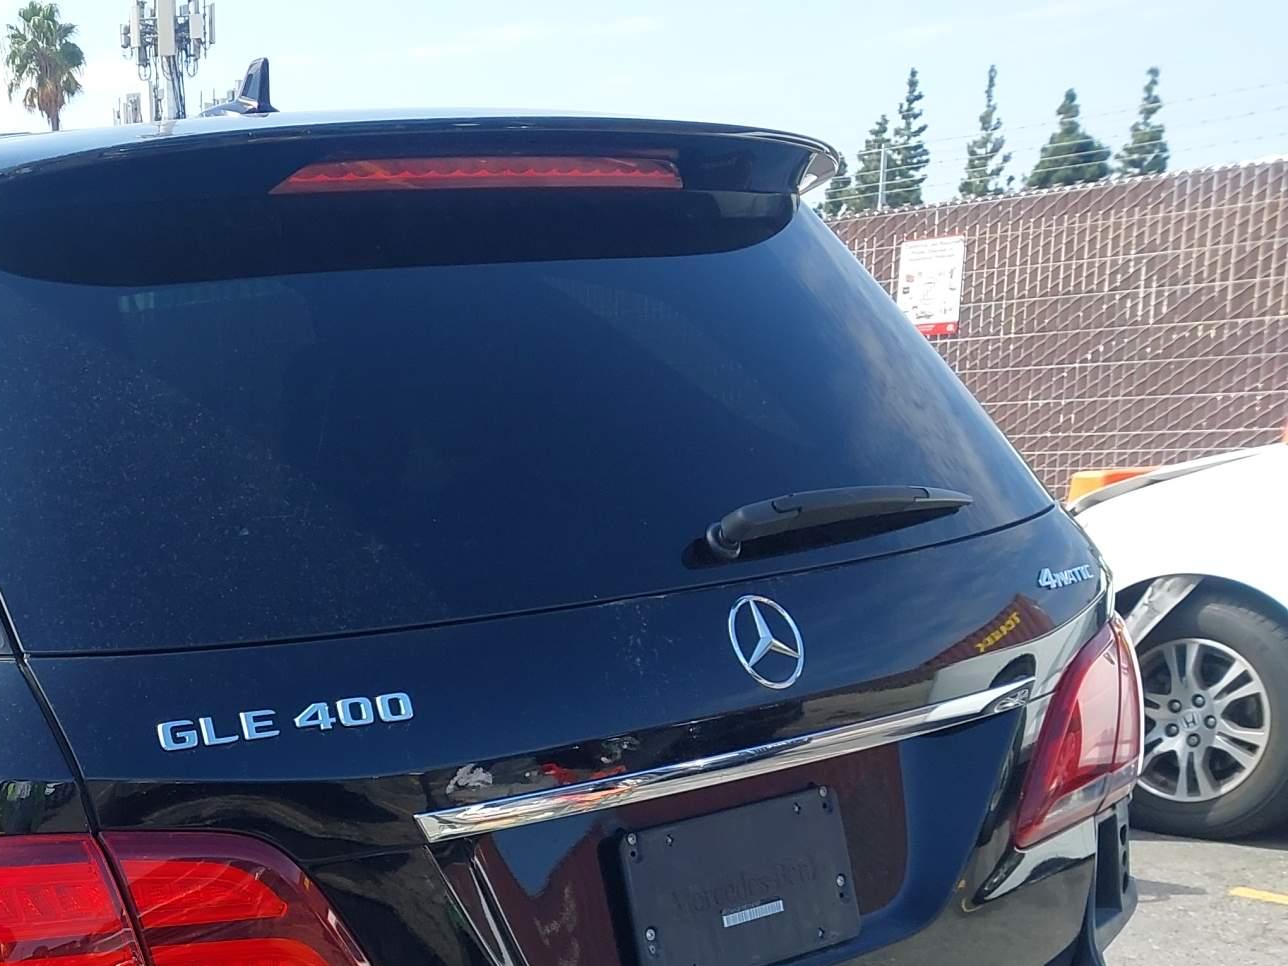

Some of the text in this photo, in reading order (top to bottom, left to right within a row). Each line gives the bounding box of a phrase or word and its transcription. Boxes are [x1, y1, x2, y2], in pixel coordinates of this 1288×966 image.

[1037, 564, 1094, 589] 4MATIC
[157, 692, 414, 751] GLE 400
